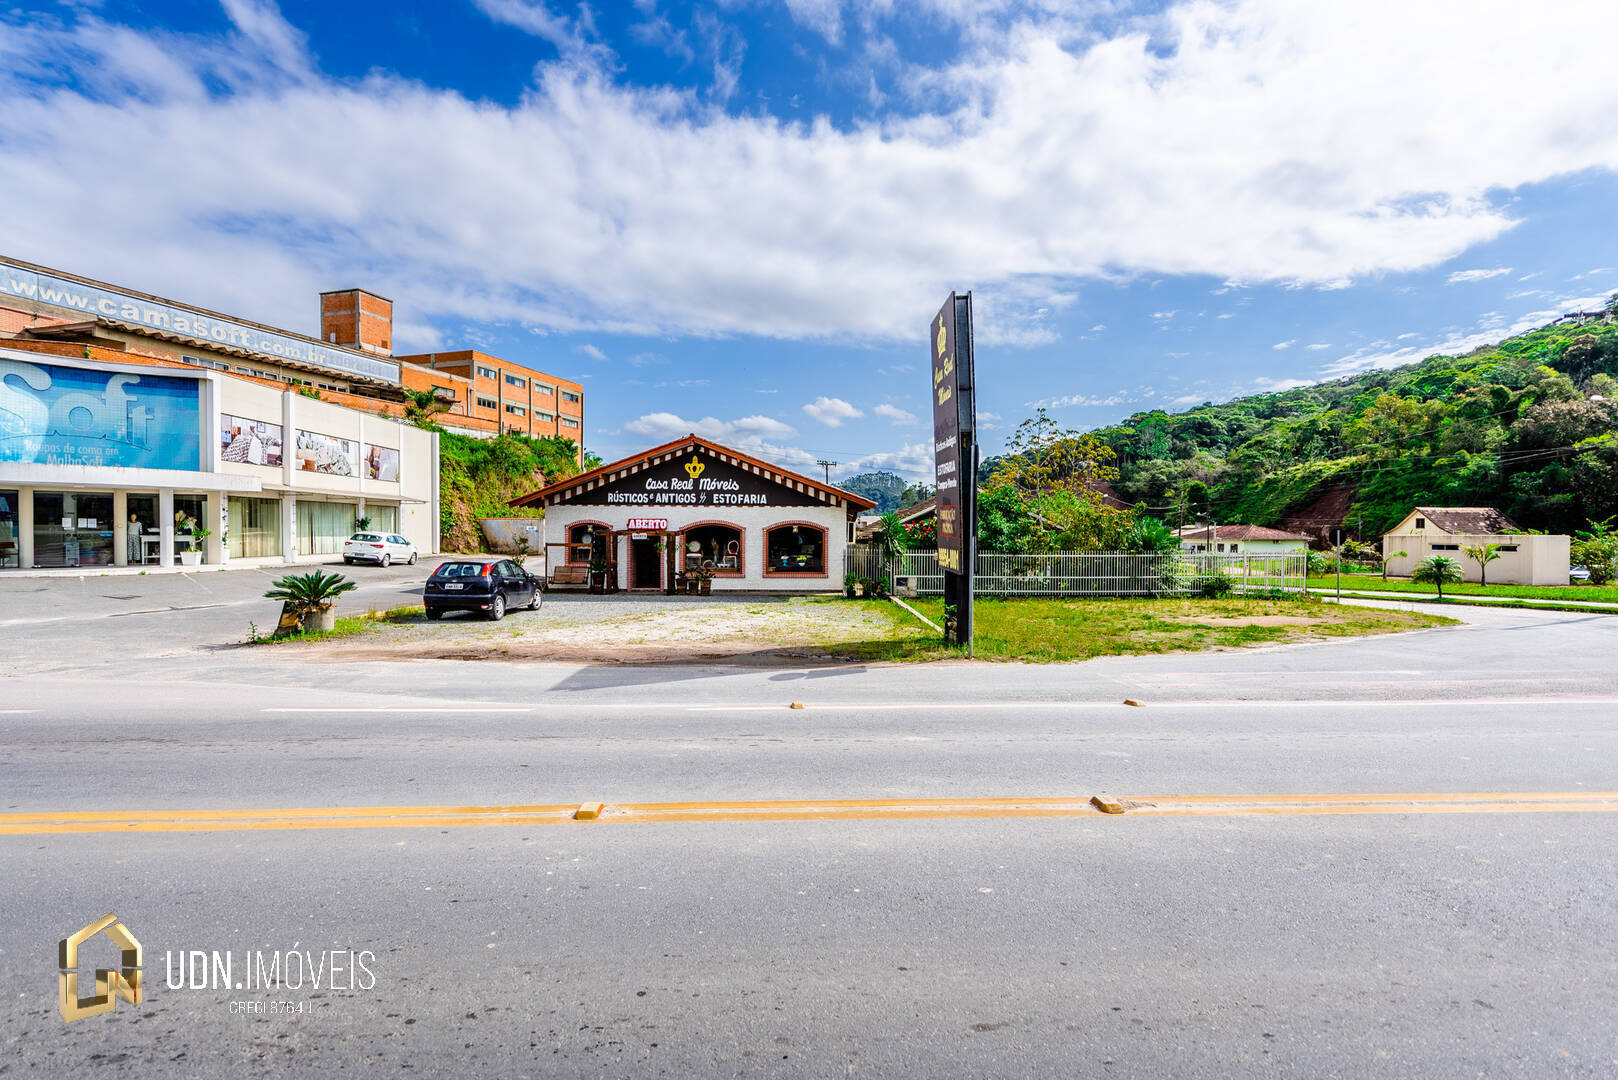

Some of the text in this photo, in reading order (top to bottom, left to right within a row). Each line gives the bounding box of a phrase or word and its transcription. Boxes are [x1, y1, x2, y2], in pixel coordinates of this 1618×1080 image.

[10, 279, 327, 364] www.camasoft.com.br
[645, 478, 740, 491] Casa Real Móveis
[607, 491, 649, 503] RÚSTICOS
[655, 493, 697, 504] ANTIGOS
[713, 493, 767, 504] ESTOFARIA
[628, 519, 667, 529] ABERTO
